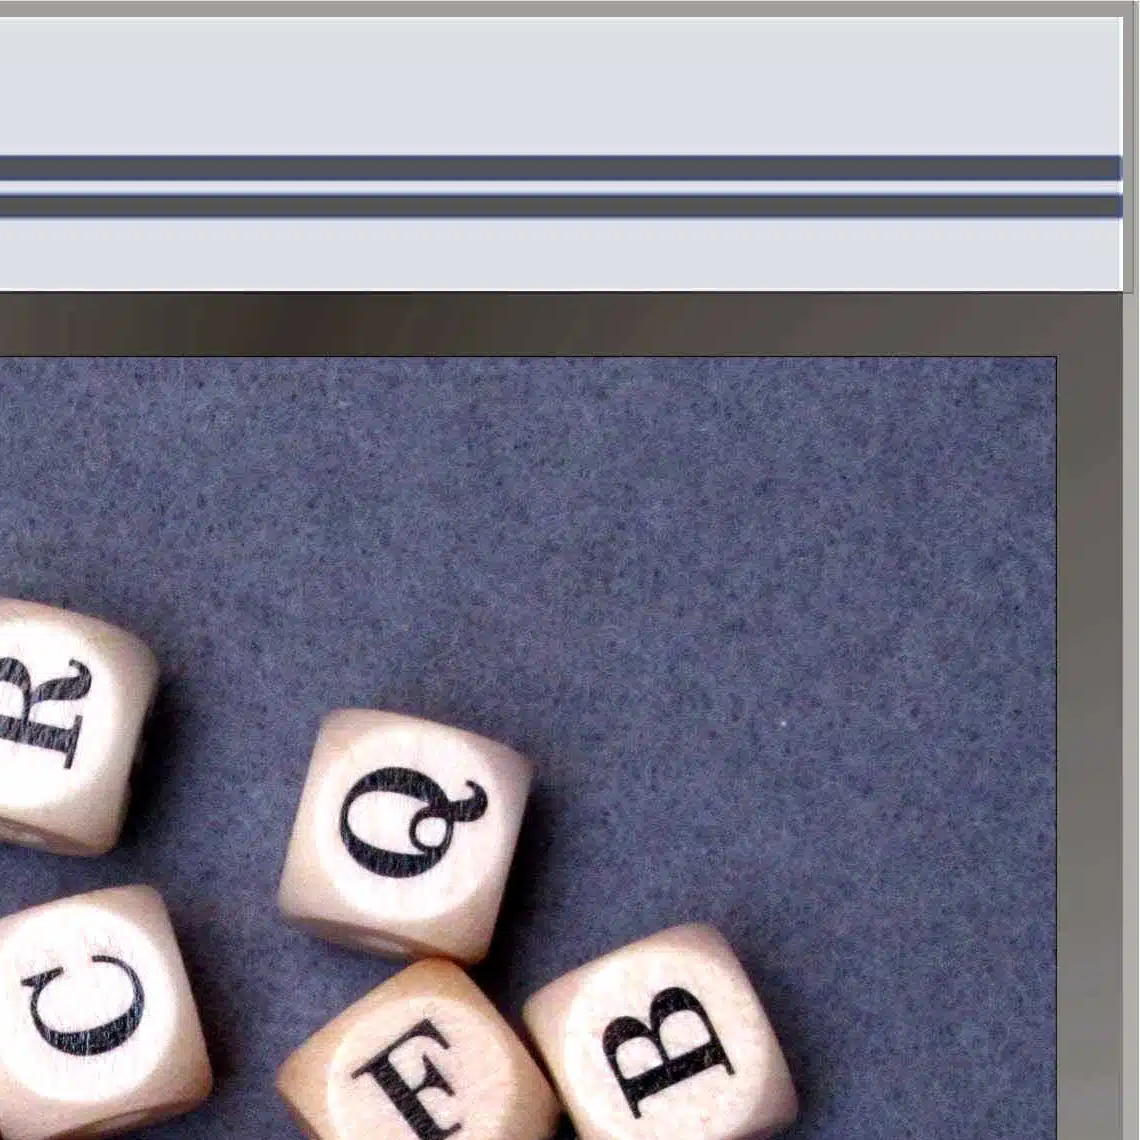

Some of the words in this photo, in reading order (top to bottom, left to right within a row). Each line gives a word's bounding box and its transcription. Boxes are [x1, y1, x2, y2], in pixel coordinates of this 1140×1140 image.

[340, 767, 488, 878] Q
[21, 955, 144, 1056] C
[603, 987, 735, 1119] B
